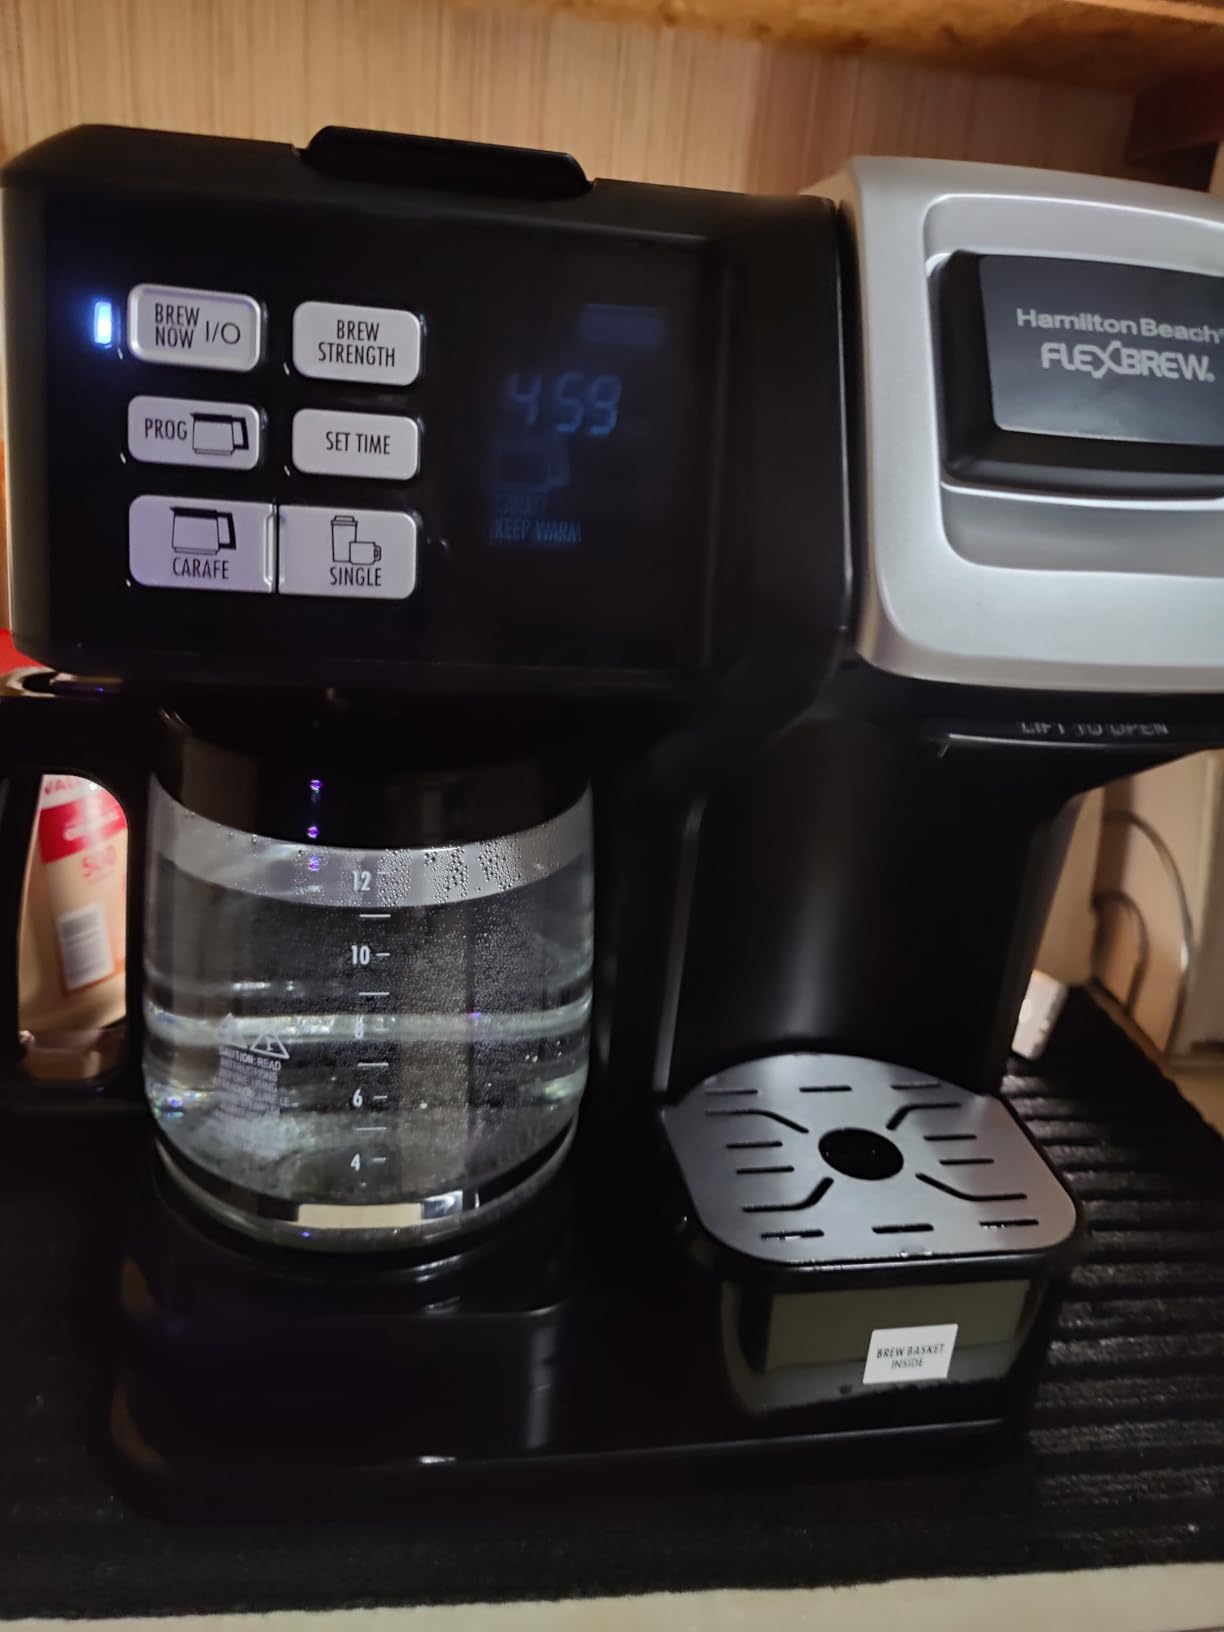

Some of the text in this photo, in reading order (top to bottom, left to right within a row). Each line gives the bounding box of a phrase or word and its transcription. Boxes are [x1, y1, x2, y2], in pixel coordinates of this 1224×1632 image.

[154, 303, 200, 327] BREW
[1015, 307, 1139, 336] Hamilton
[154, 327, 195, 349] NOW
[336, 319, 380, 342] BREW
[317, 341, 395, 368] STRENGTH
[144, 417, 188, 441] PROG
[325, 430, 391, 455] SET TIME
[172, 556, 230, 580] CARAFE
[329, 565, 382, 587] SINGLE
[351, 869, 372, 892] 12
[351, 945, 371, 965] 10
[352, 1088, 363, 1107] 6
[350, 1153, 361, 1171] 4
[876, 1343, 945, 1359] BREW BASKET
[890, 1358, 924, 1369] INSIDE
